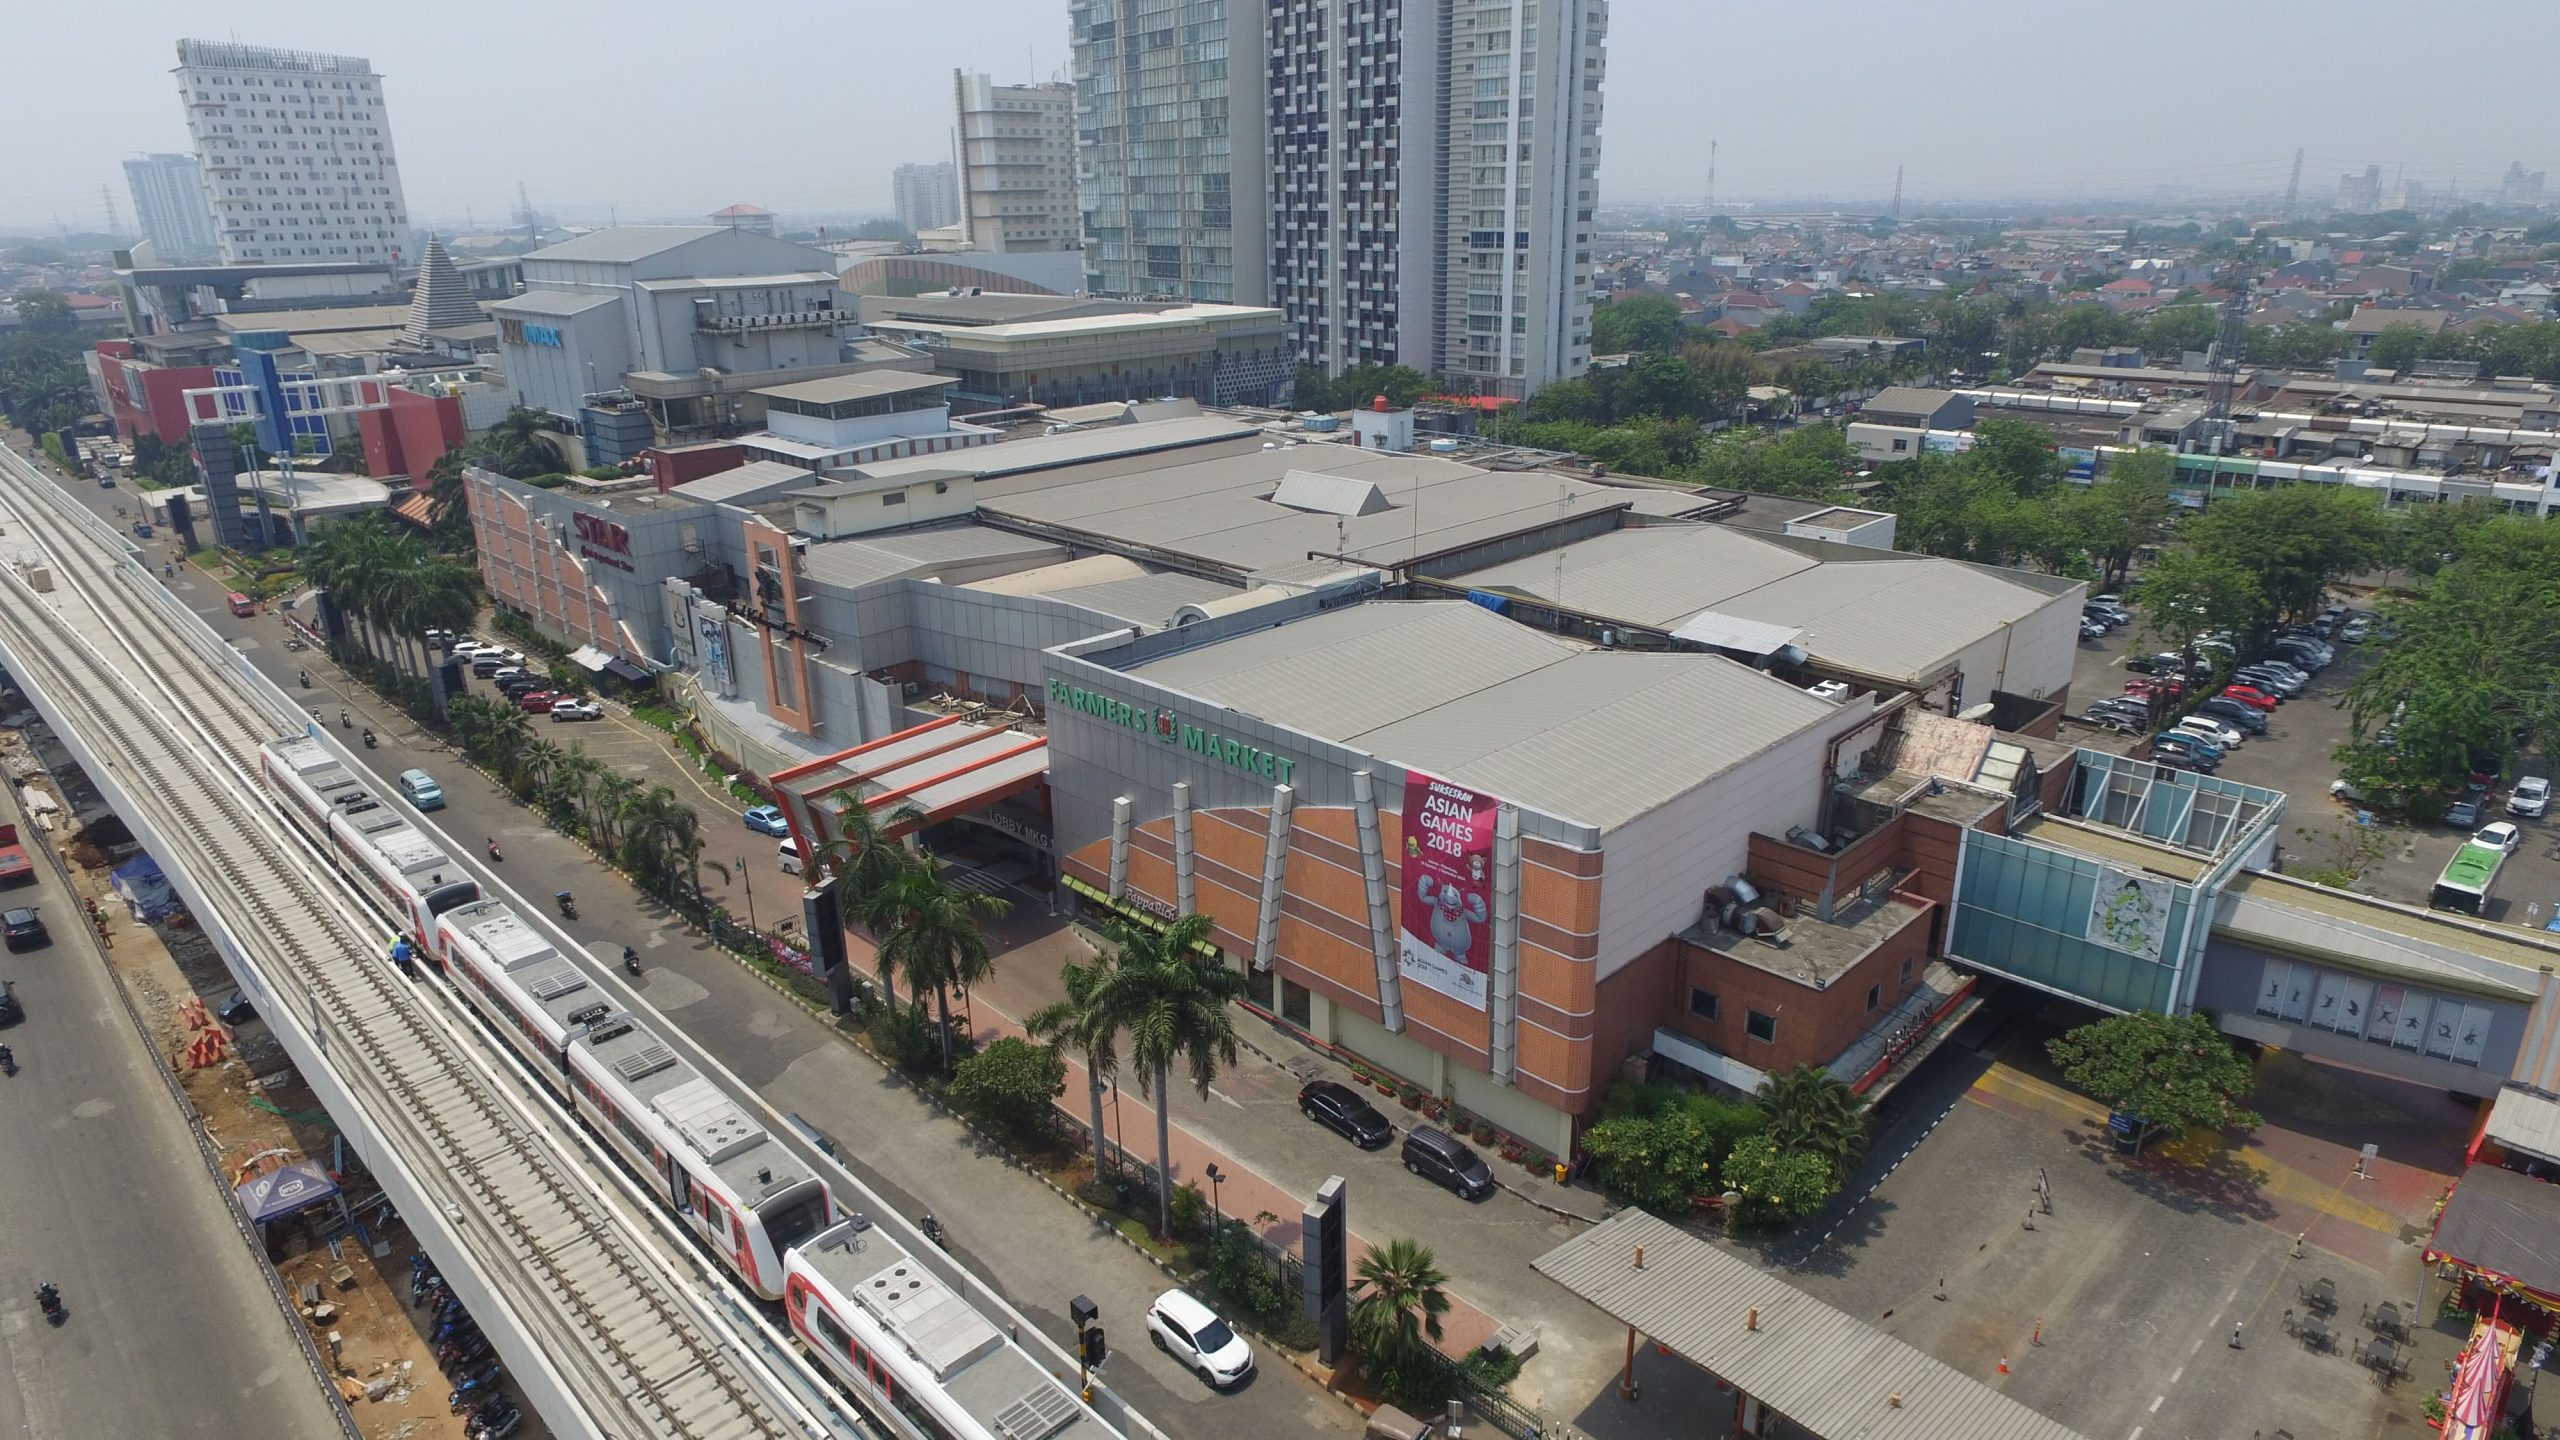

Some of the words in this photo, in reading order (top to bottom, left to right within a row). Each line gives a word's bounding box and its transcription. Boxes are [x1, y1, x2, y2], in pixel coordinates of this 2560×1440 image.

[524, 323, 562, 348] IMAX
[573, 511, 632, 557] STAR
[1049, 678, 1147, 733] FARMERS
[1183, 724, 1295, 785] MARKET
[1429, 781, 1473, 803] SUKSESKAN
[1424, 794, 1473, 824] ASIAN
[989, 809, 1022, 834] LOBBY
[1025, 826, 1048, 846] MKG
[1420, 811, 1473, 842] GAMES
[1427, 832, 1462, 858] 2018
[1125, 887, 1175, 921] PappaRich
